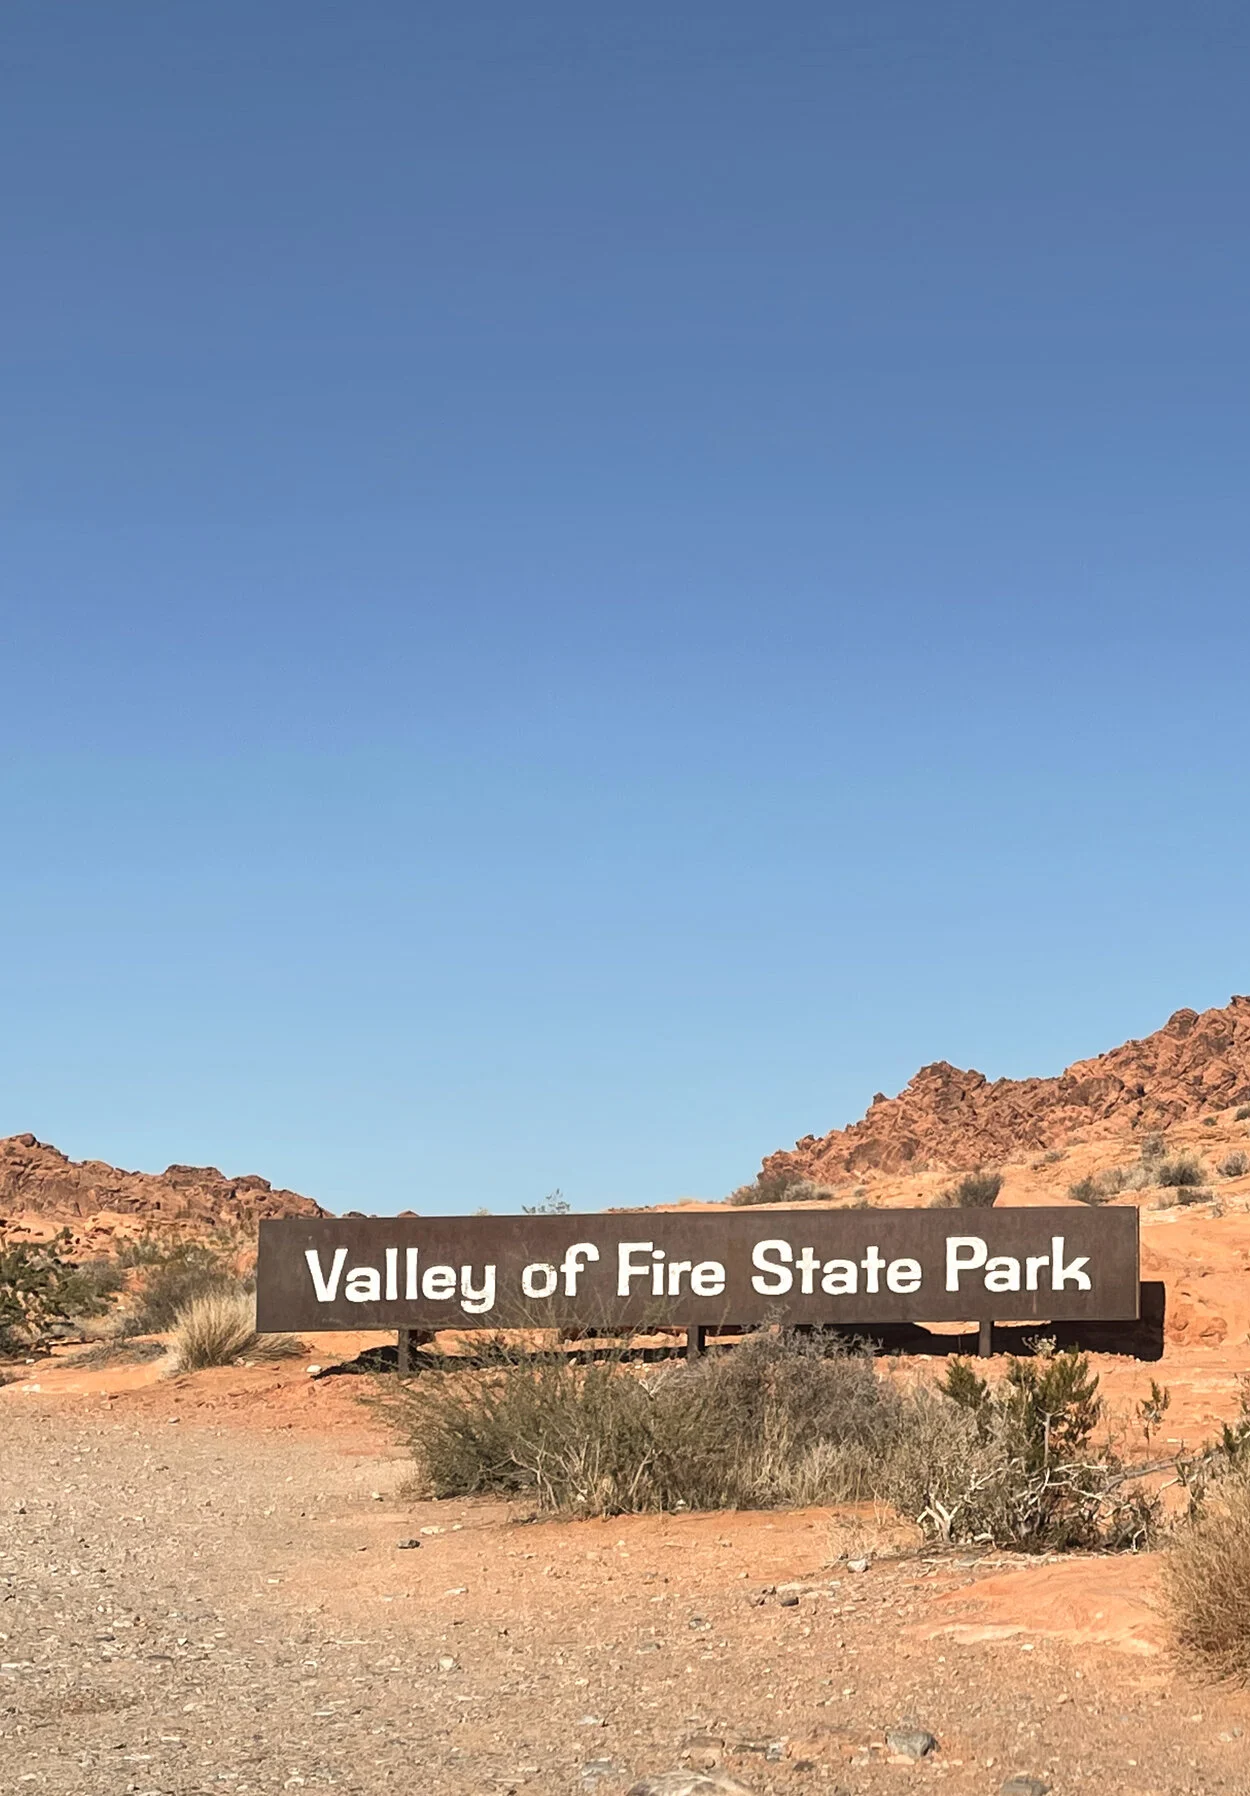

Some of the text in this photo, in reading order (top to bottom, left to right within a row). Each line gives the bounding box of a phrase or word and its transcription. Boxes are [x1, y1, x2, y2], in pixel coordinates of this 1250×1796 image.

[304, 1235, 1093, 1314] Valley of Fire State Park
